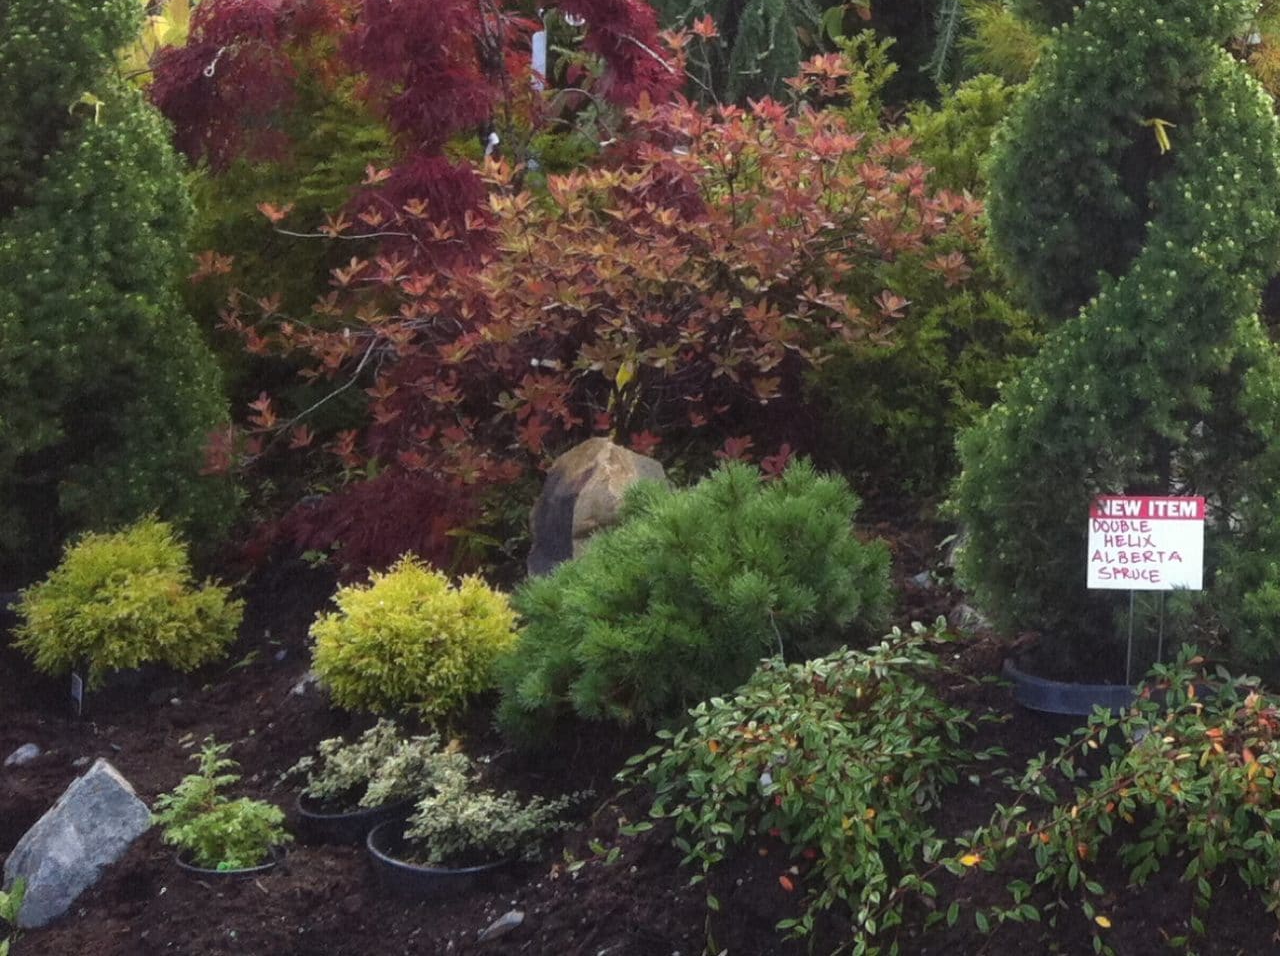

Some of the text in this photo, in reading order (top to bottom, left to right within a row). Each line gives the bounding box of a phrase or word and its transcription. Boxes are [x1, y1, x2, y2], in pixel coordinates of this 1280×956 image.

[1097, 499, 1198, 517] NEW ITEM
[1092, 519, 1152, 533] DOUBLE
[1104, 534, 1156, 548] HELIX
[1091, 549, 1183, 564] ALBERTA
[1098, 566, 1161, 583] SPRUCE
